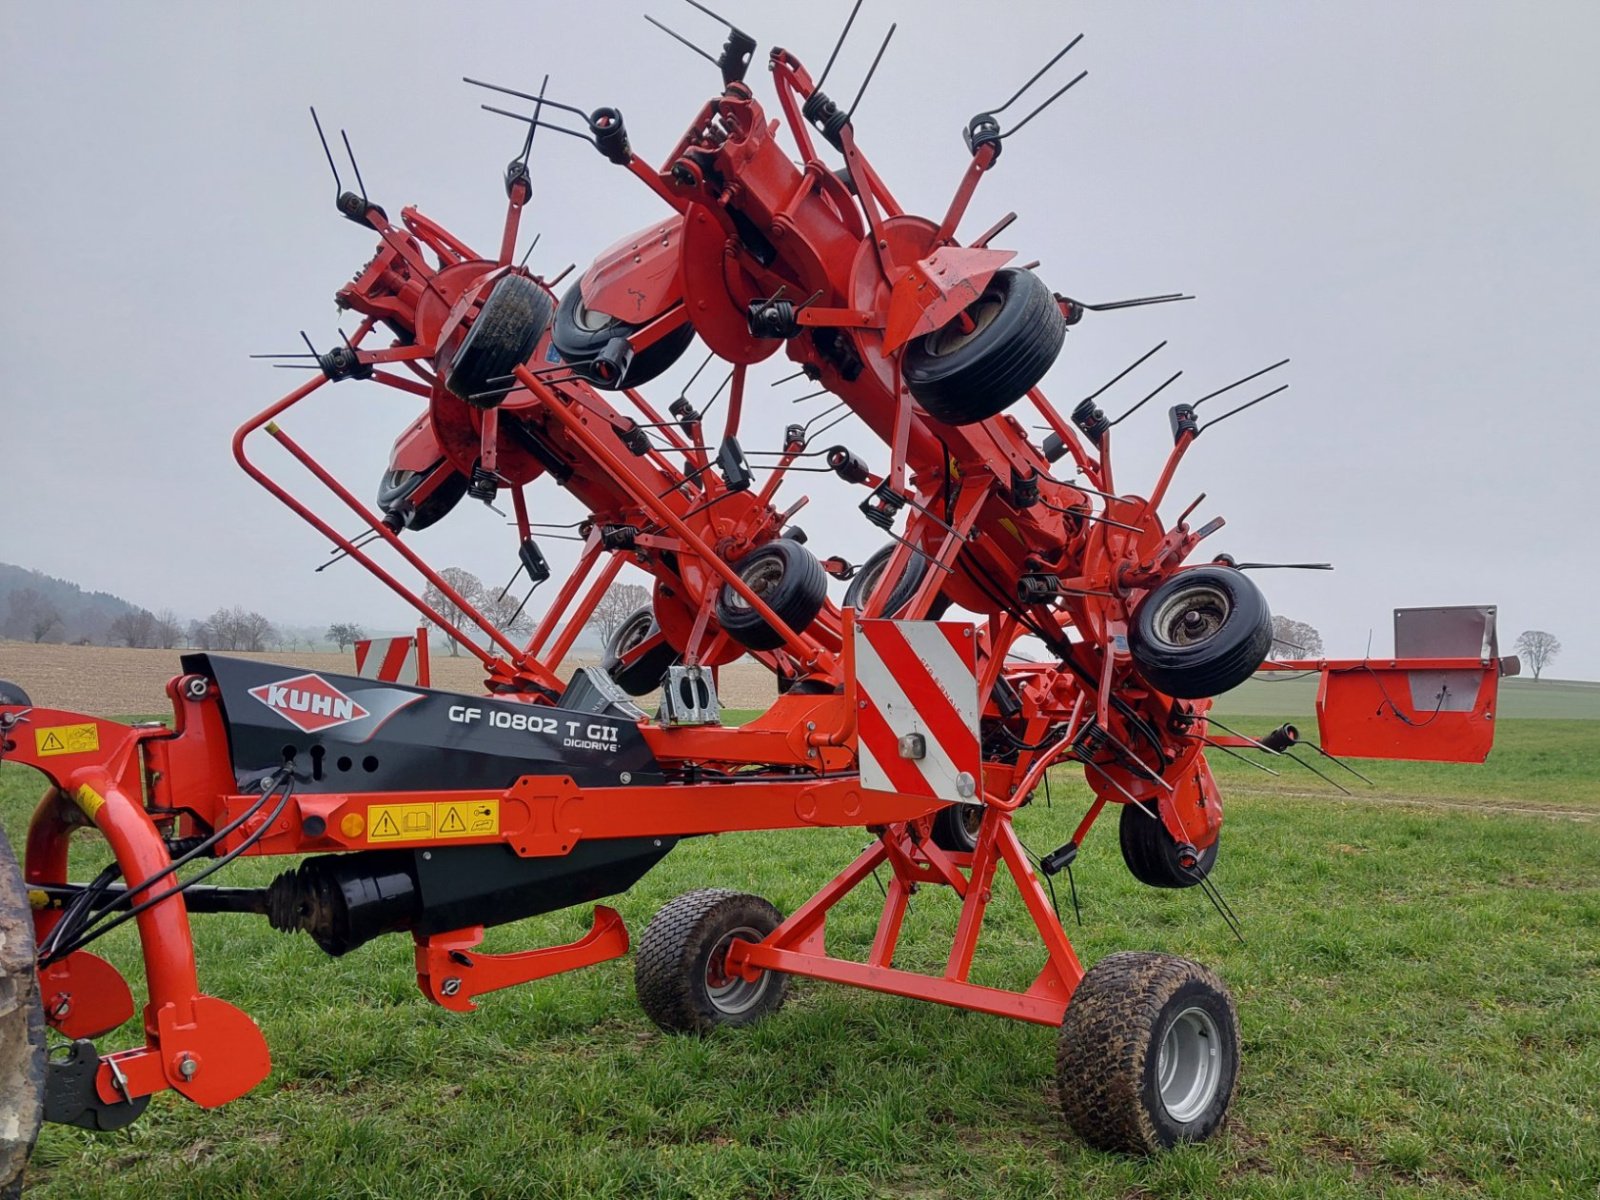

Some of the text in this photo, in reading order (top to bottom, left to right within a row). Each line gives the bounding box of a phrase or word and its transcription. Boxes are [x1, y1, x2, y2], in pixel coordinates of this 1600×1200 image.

[267, 685, 354, 720] KUHN
[449, 705, 618, 742] GF 10802 T GII
[563, 738, 617, 752] DIGIDRIVE
